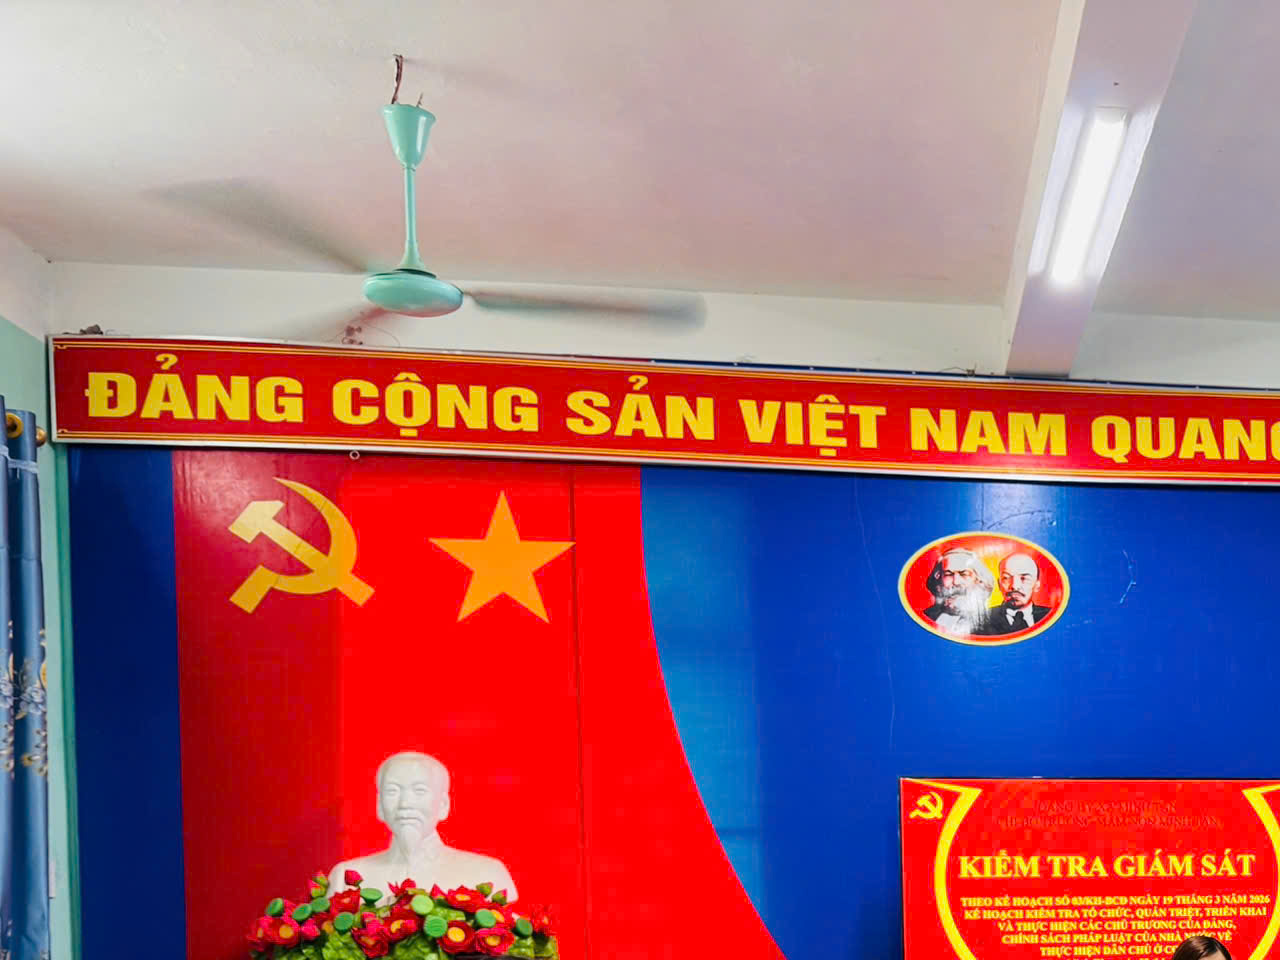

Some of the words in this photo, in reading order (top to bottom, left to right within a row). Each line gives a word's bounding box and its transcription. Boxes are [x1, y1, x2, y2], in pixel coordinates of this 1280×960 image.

[85, 353, 304, 422] ĐẢNG
[331, 373, 539, 436] CỘNG
[567, 375, 715, 440] SẢN
[738, 394, 887, 457] VIỆT
[910, 408, 1067, 456] NAM
[958, 849, 1041, 878] KIỂM
[1047, 855, 1109, 878] TRA
[1113, 849, 1194, 877] GIÁM
[1201, 848, 1256, 876] SÁT
[1176, 893, 1213, 905] THÁNG
